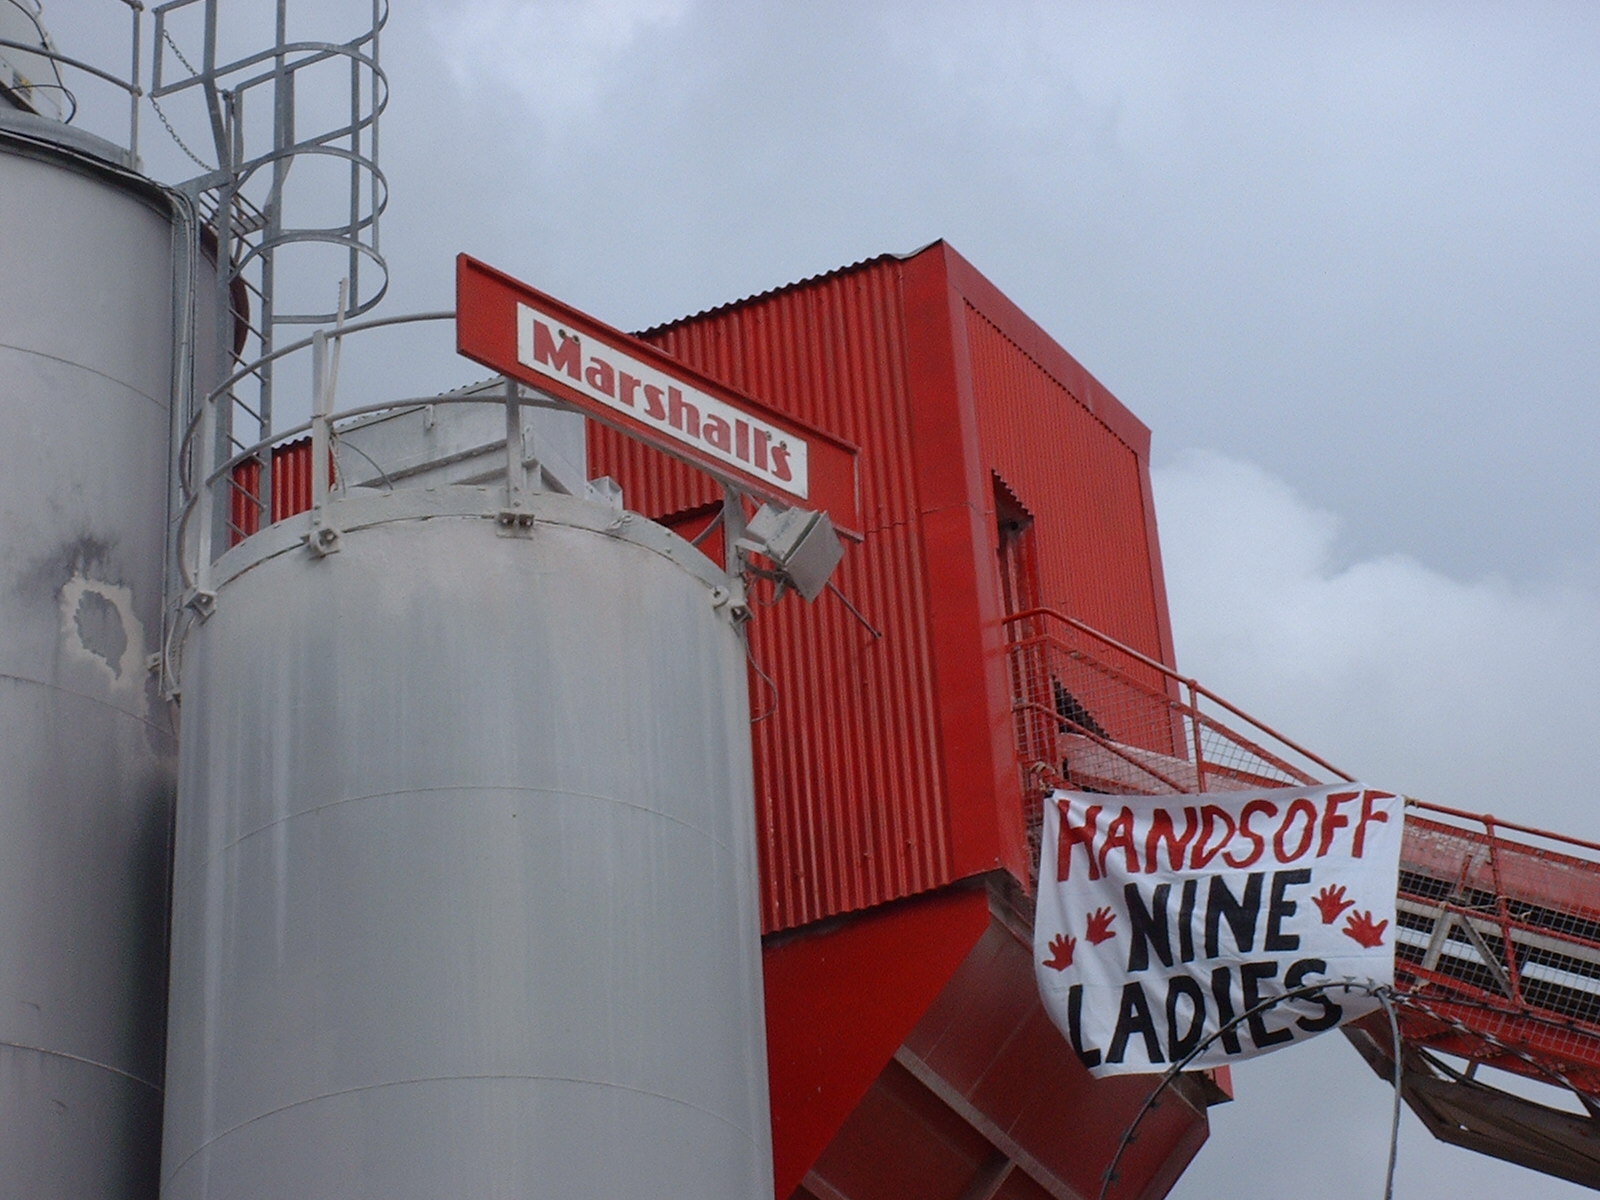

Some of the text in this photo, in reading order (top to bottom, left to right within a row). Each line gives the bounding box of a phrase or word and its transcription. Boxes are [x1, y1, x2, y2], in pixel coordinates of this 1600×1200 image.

[533, 319, 793, 482] Marshalls
[1124, 868, 1312, 971] NINE
[1068, 958, 1344, 1068] LADIES
